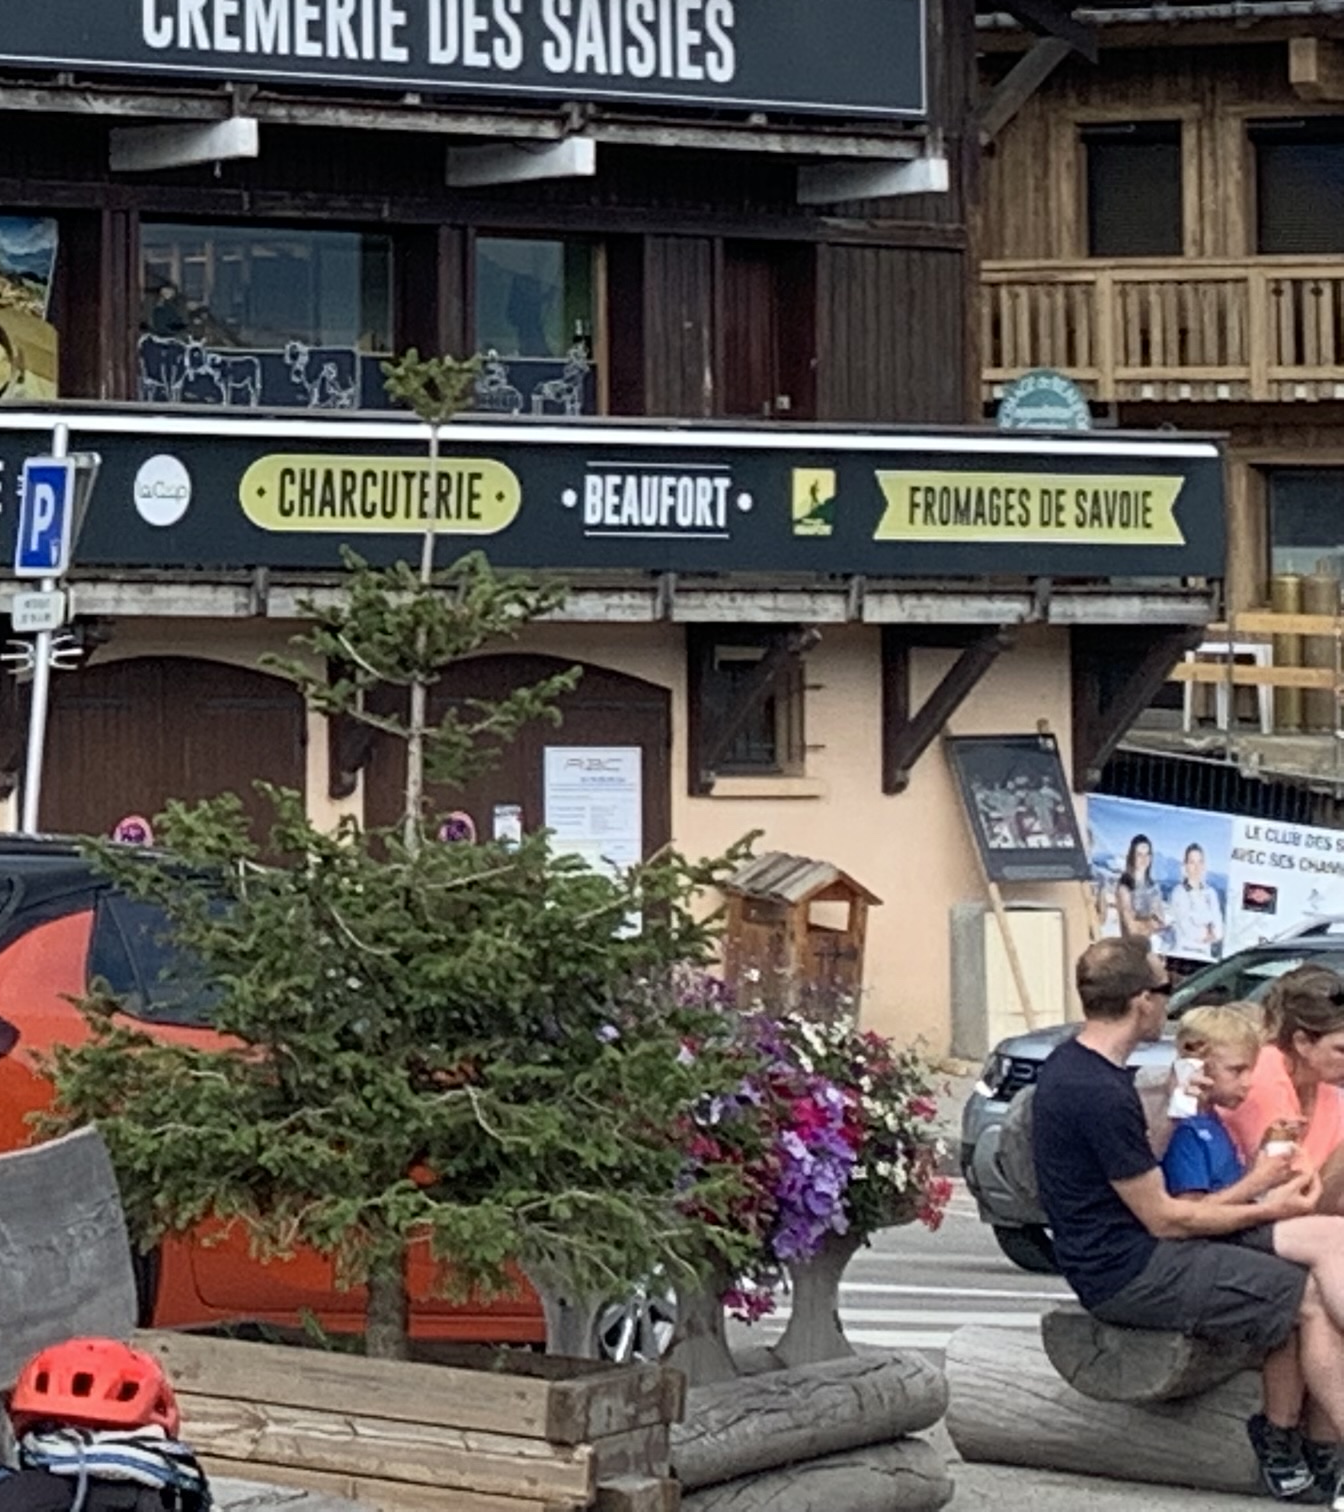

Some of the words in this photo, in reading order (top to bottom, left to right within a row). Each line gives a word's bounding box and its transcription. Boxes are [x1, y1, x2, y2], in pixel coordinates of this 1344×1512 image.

[30, 483, 56, 552] P
[278, 467, 483, 521] CHARCUTERIE
[583, 472, 730, 530] BEAUFORT
[908, 486, 1031, 528] FROMAGES
[1039, 488, 1067, 528] DE
[1074, 488, 1153, 529] SAVOIE
[1245, 824, 1262, 841] LE
[1265, 827, 1302, 846] CLUB
[1304, 833, 1332, 851] DES
